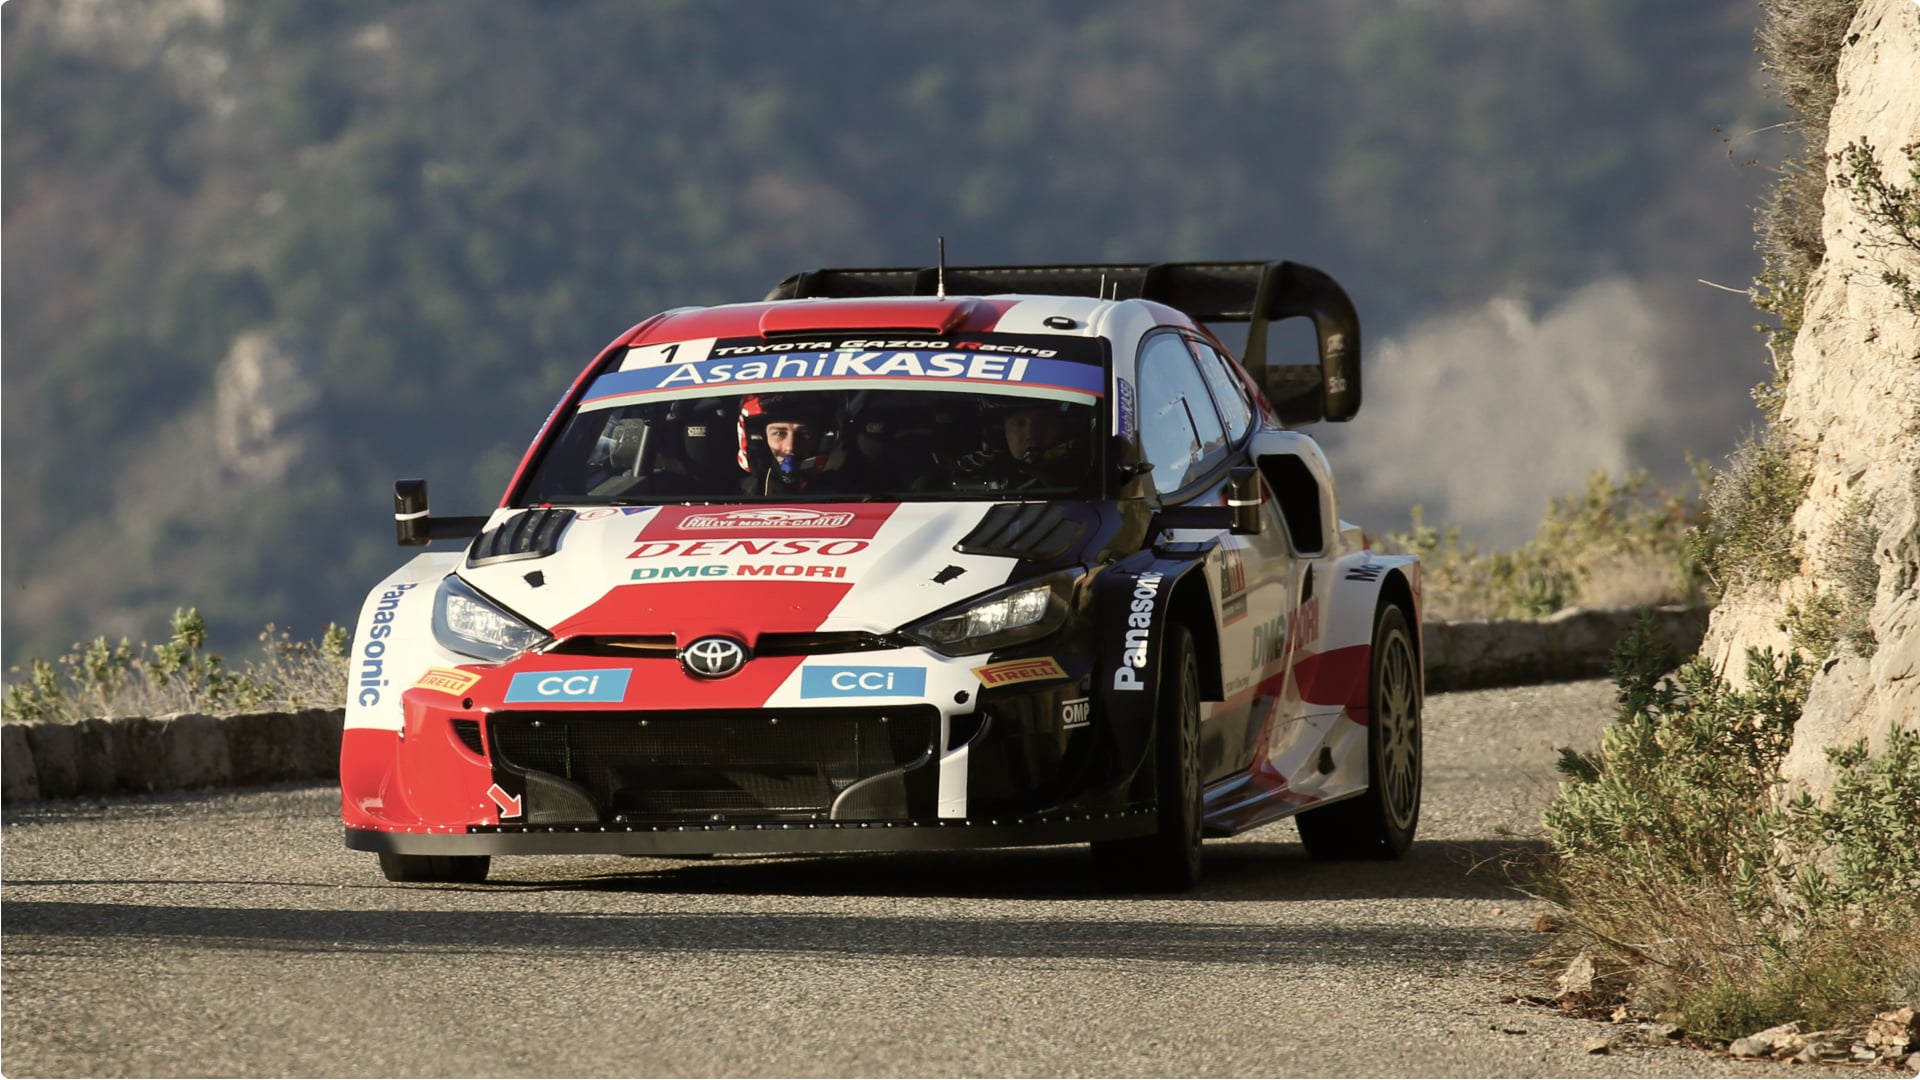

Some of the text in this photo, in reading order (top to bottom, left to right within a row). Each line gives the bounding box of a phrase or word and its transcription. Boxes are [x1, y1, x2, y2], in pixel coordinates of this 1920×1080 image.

[660, 344, 681, 364] 1
[715, 339, 1058, 358] TOYOTA GAZOO Racing
[688, 516, 736, 528] RALLYE
[625, 540, 870, 560] DENSO
[630, 564, 847, 581] DMG MORI
[1113, 571, 1165, 691] Panasonic
[358, 583, 419, 707] Panasonic
[417, 670, 474, 692] PIRELLI
[978, 660, 1060, 684] PIRELLI
[1062, 701, 1091, 724] OMP
